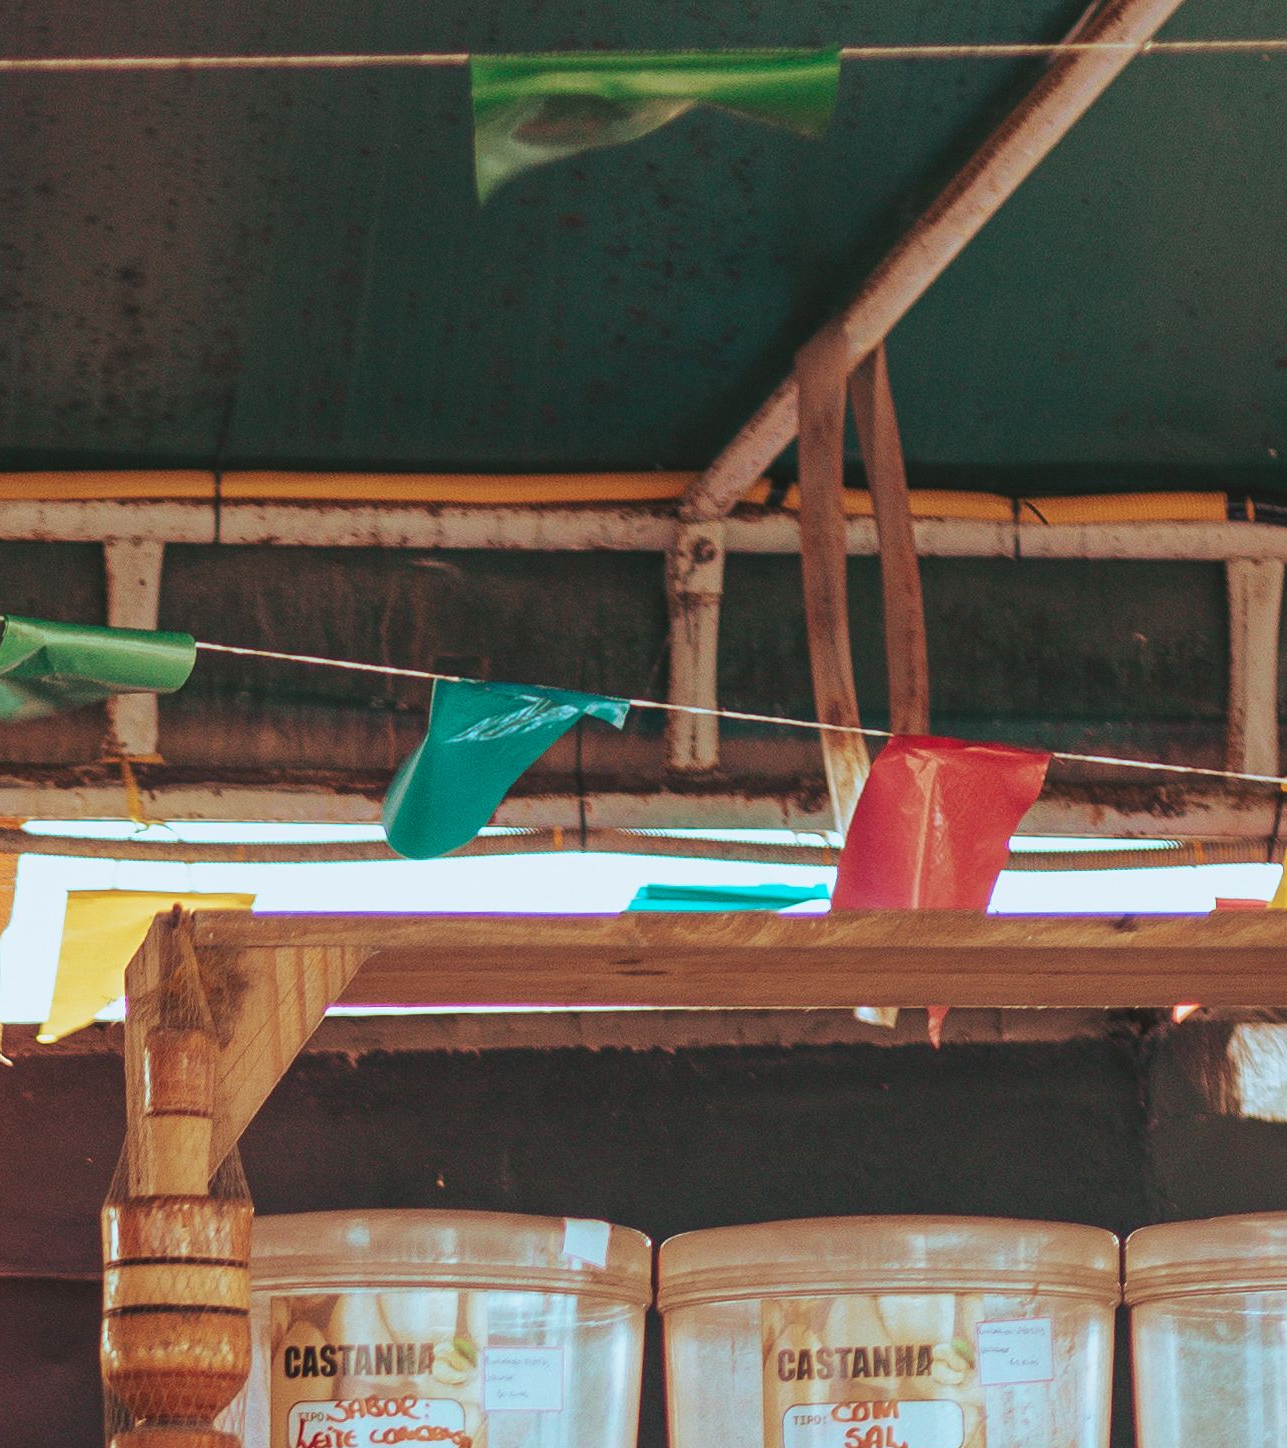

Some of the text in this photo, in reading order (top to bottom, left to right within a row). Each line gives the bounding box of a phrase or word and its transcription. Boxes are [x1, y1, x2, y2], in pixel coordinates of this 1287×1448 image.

[284, 1342, 435, 1379] CASTANHA
[778, 1345, 934, 1382] CASTANHA
[830, 1400, 900, 1423] COM
